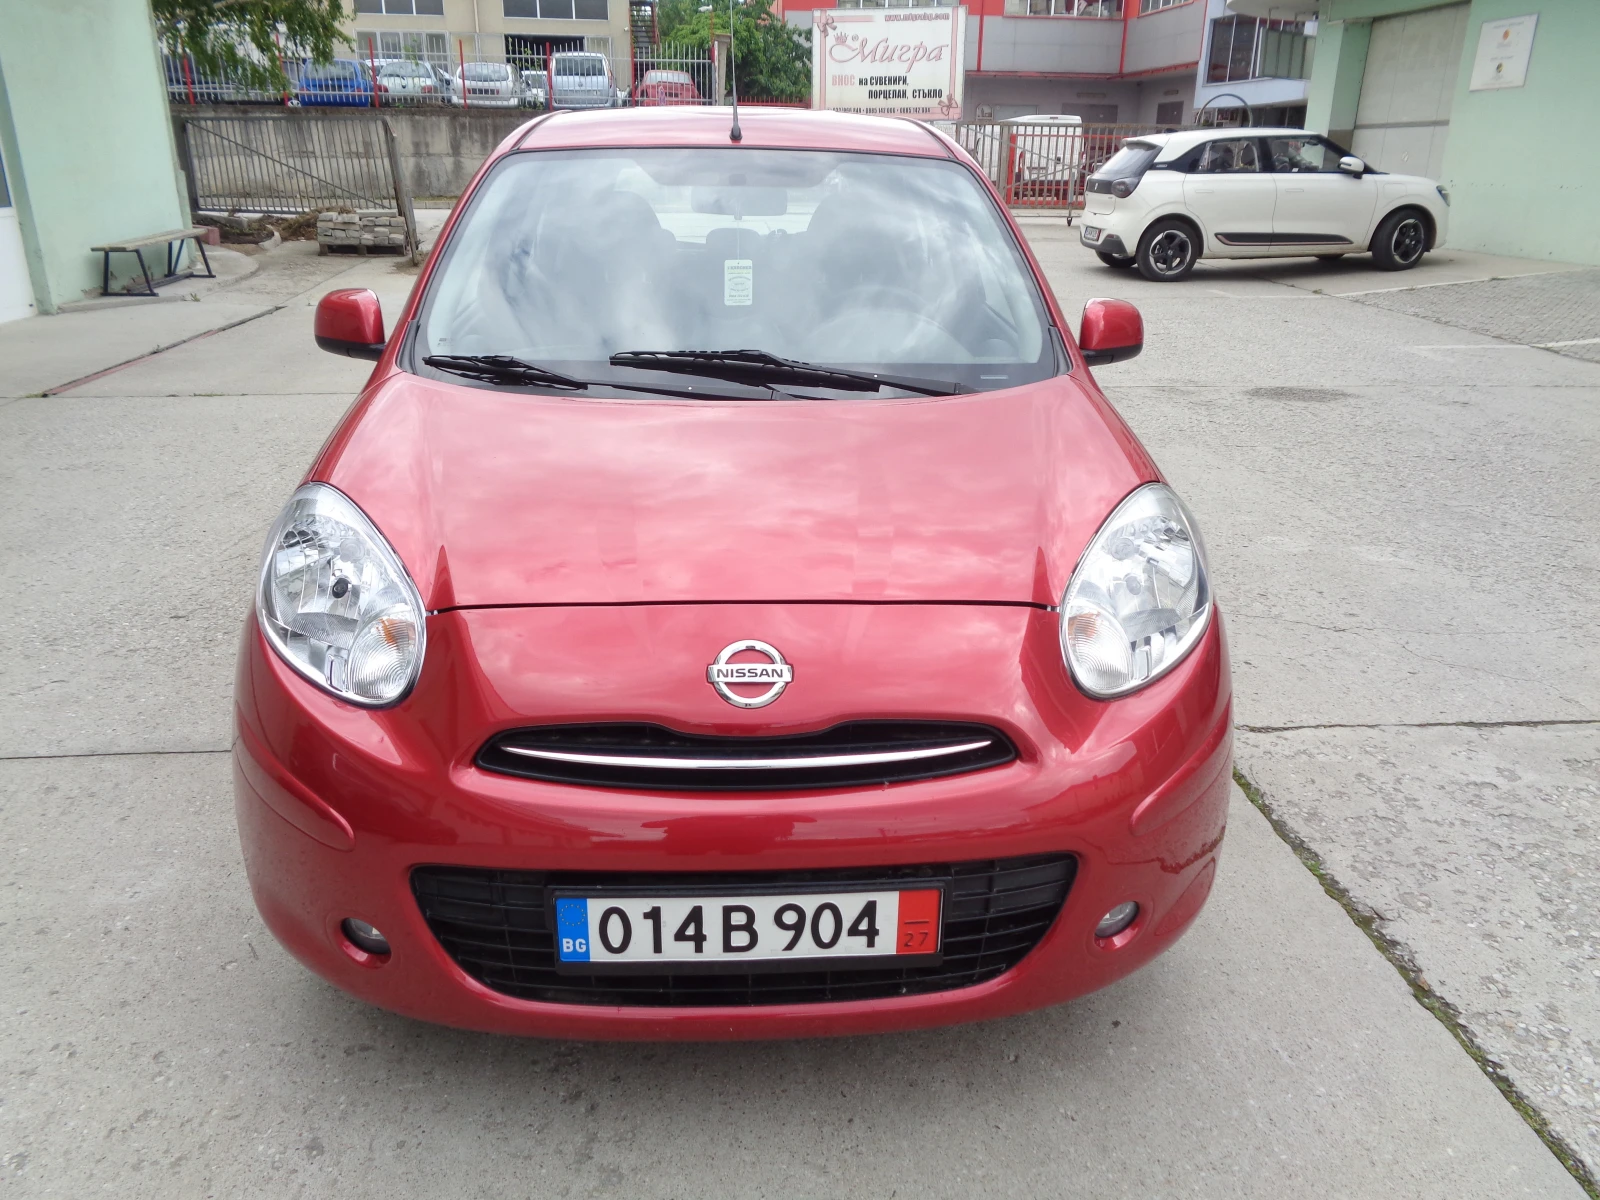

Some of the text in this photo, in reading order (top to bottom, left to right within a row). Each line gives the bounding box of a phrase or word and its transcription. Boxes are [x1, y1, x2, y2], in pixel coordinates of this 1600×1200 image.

[829, 37, 949, 73] Мигра
[831, 75, 909, 86] ВНОС на СУВЕНИРИ,
[868, 88, 943, 100] ПОРЦЕЛАН, СТЪКЛО
[716, 668, 783, 678] NISSAN
[562, 938, 587, 952] BG
